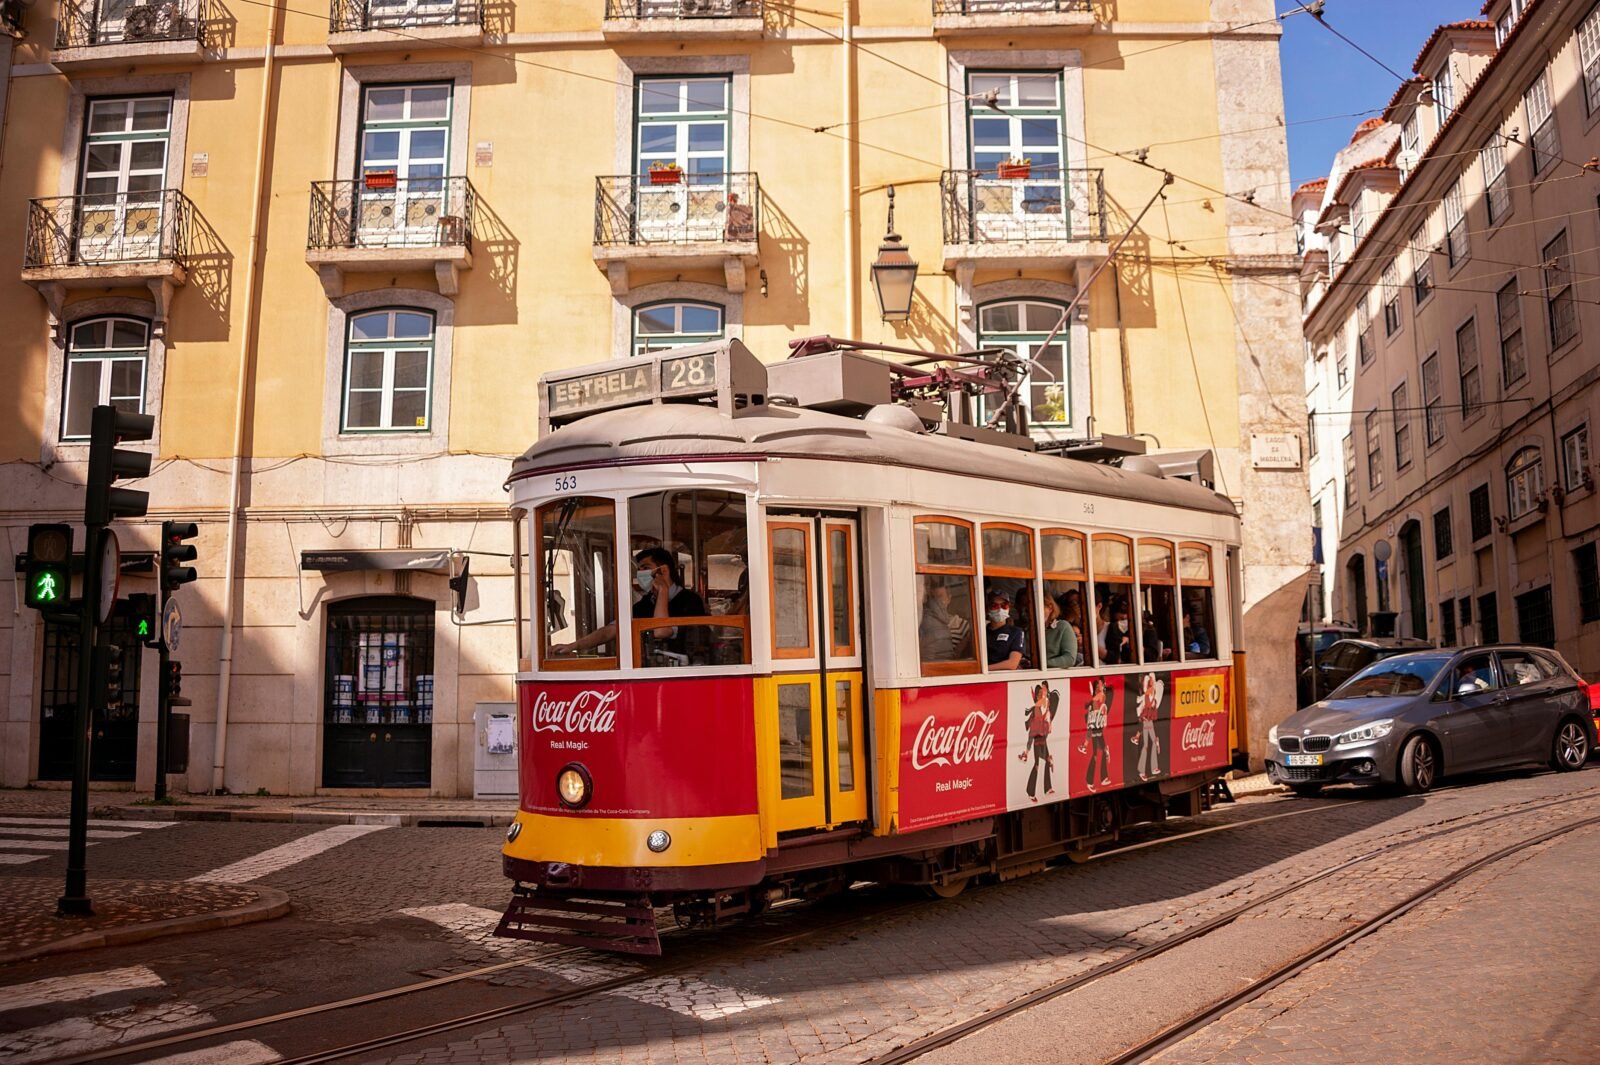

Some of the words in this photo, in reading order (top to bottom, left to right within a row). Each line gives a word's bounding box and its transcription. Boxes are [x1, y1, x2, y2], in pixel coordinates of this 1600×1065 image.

[555, 369, 649, 402] ESTRELA
[671, 357, 705, 388] 28
[555, 475, 576, 491] 563
[1083, 502, 1095, 514] 563
[1180, 684, 1206, 705] carris
[532, 689, 623, 733] Coca-Cola
[550, 740, 565, 749] Real
[566, 740, 588, 750] Magic
[912, 709, 1000, 771] Coca-Cola
[1181, 719, 1216, 751] Coca-Cola
[935, 780, 952, 792] Real
[952, 777, 973, 790] Magic
